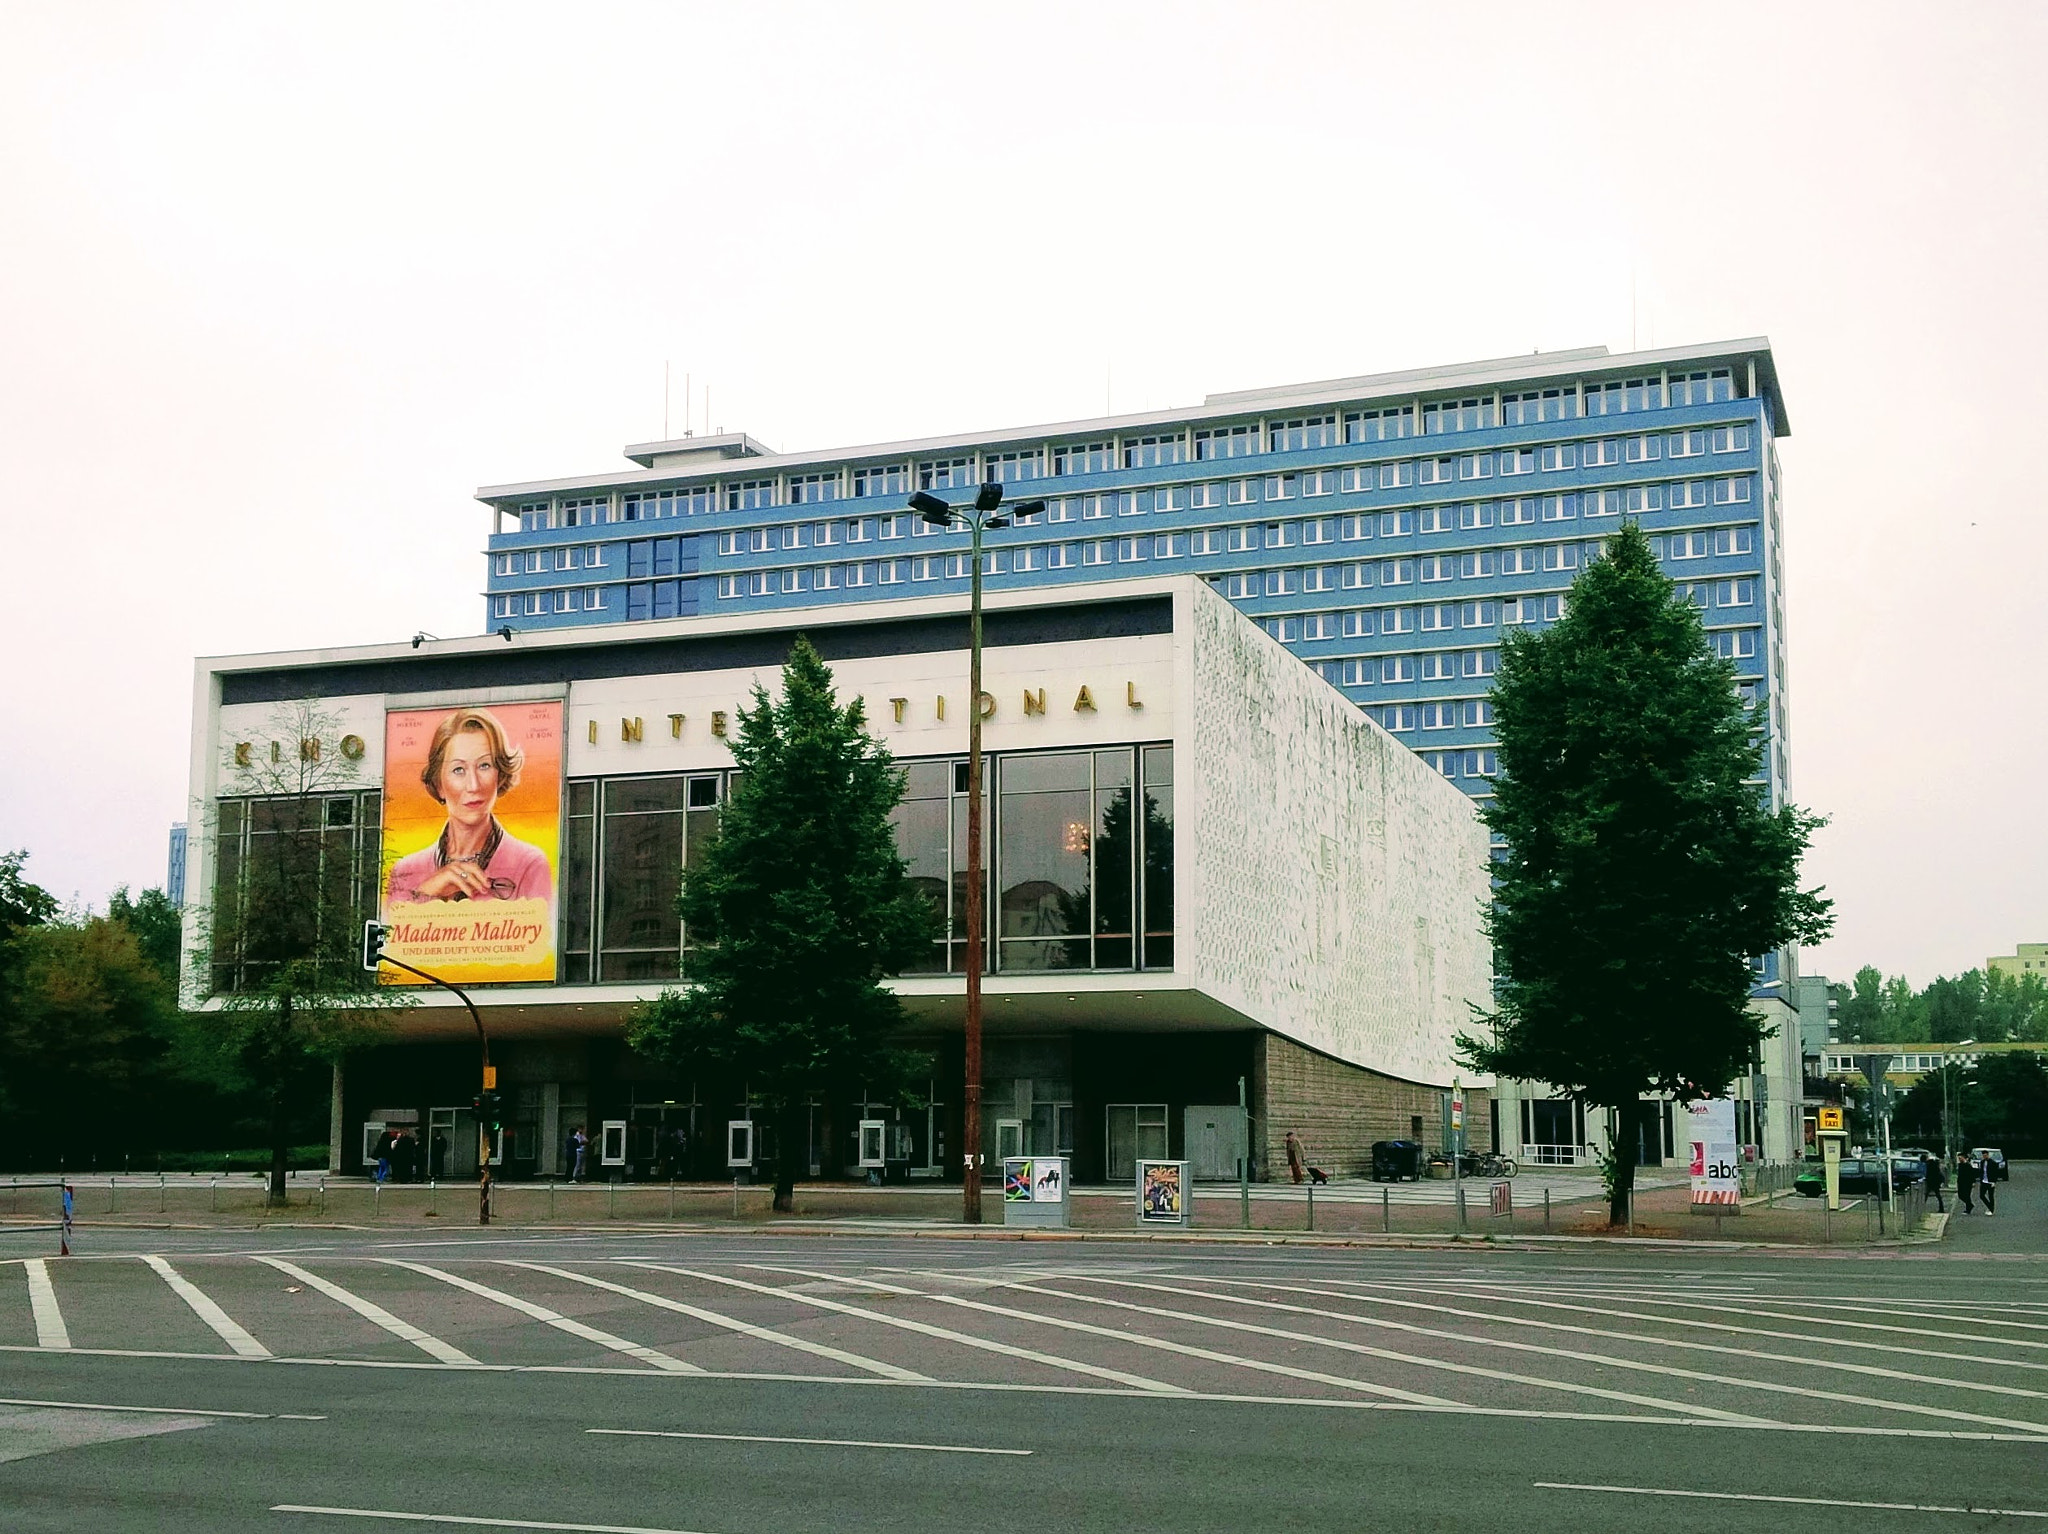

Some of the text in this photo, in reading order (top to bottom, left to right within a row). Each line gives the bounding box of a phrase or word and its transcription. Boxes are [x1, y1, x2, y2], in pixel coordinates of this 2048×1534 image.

[588, 681, 1144, 744] INTETIONAL
[234, 734, 365, 768] KINO
[390, 919, 542, 944] Madame Mallory
[402, 944, 526, 956] UND DER DUFT VON CURRY
